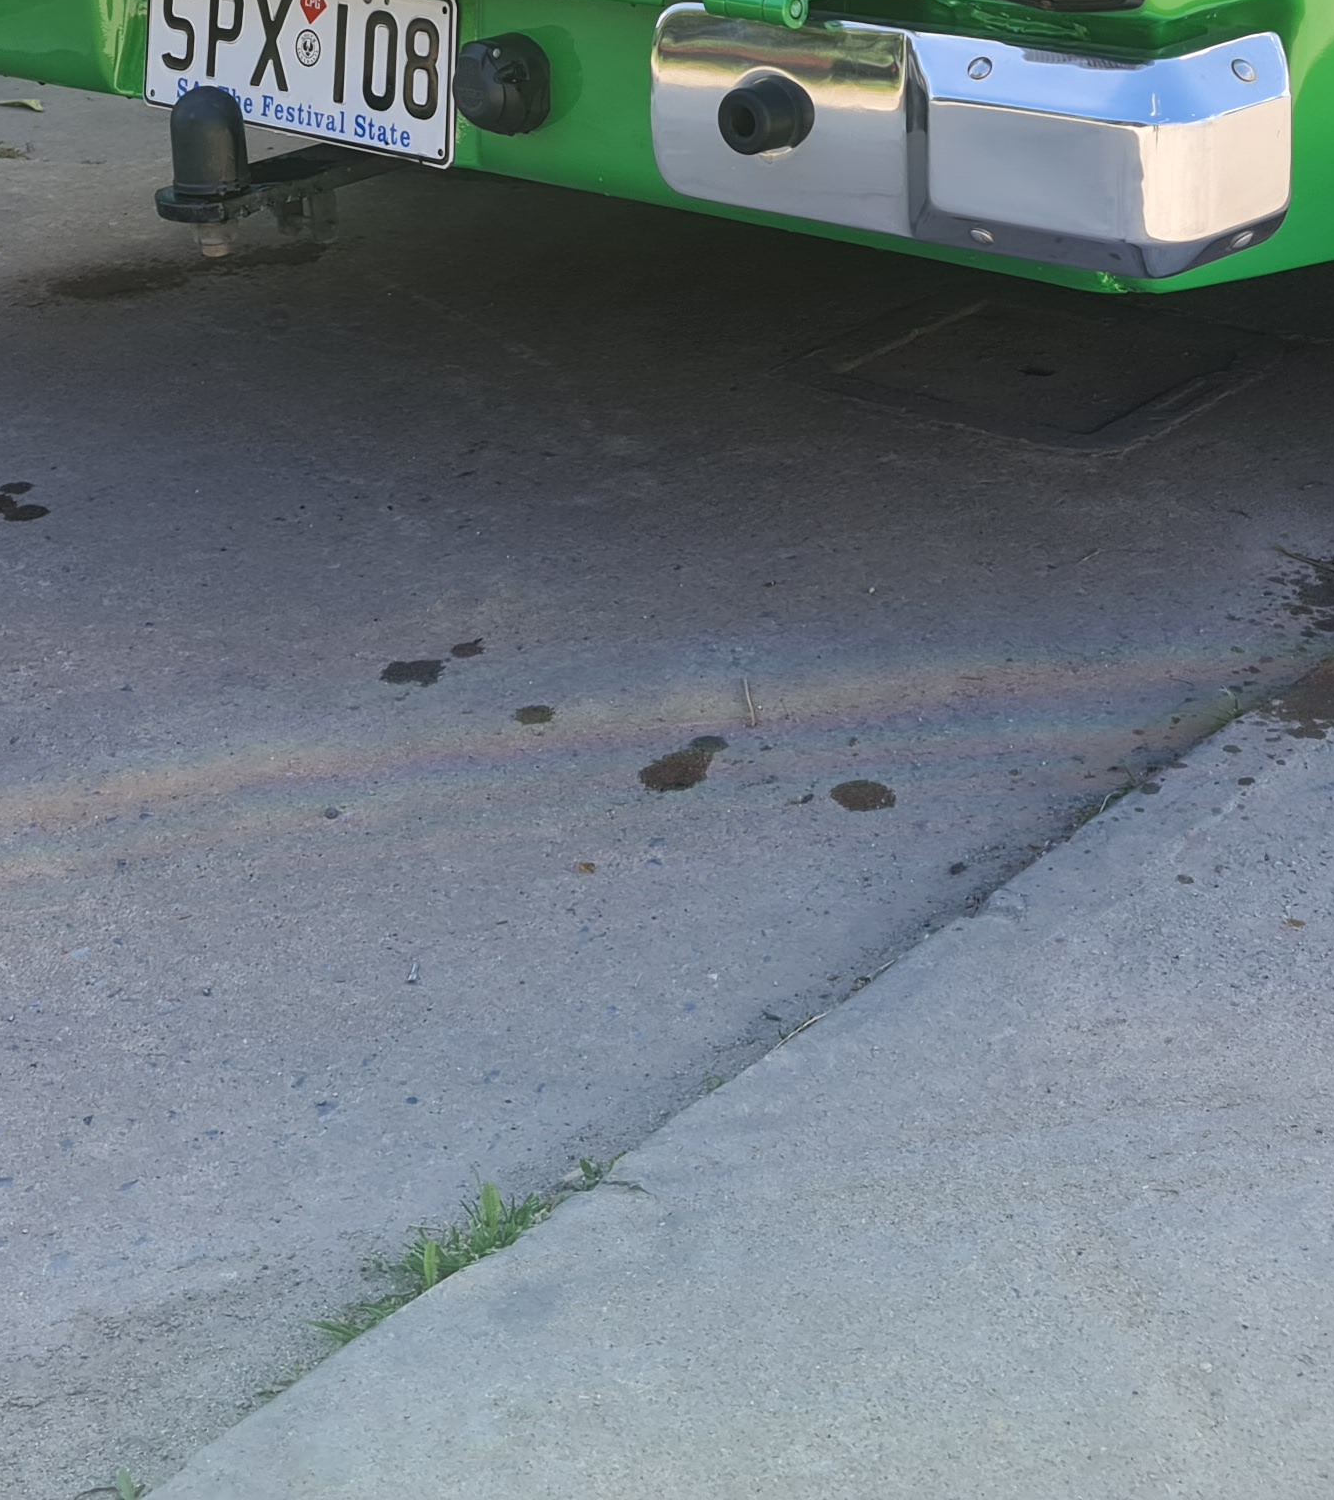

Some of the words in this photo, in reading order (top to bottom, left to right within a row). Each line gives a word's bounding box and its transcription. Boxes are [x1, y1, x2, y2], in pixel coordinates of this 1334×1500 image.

[333, 3, 440, 120] 108
[217, 86, 253, 114] he
[261, 95, 346, 134] Festival
[354, 114, 411, 147] State
